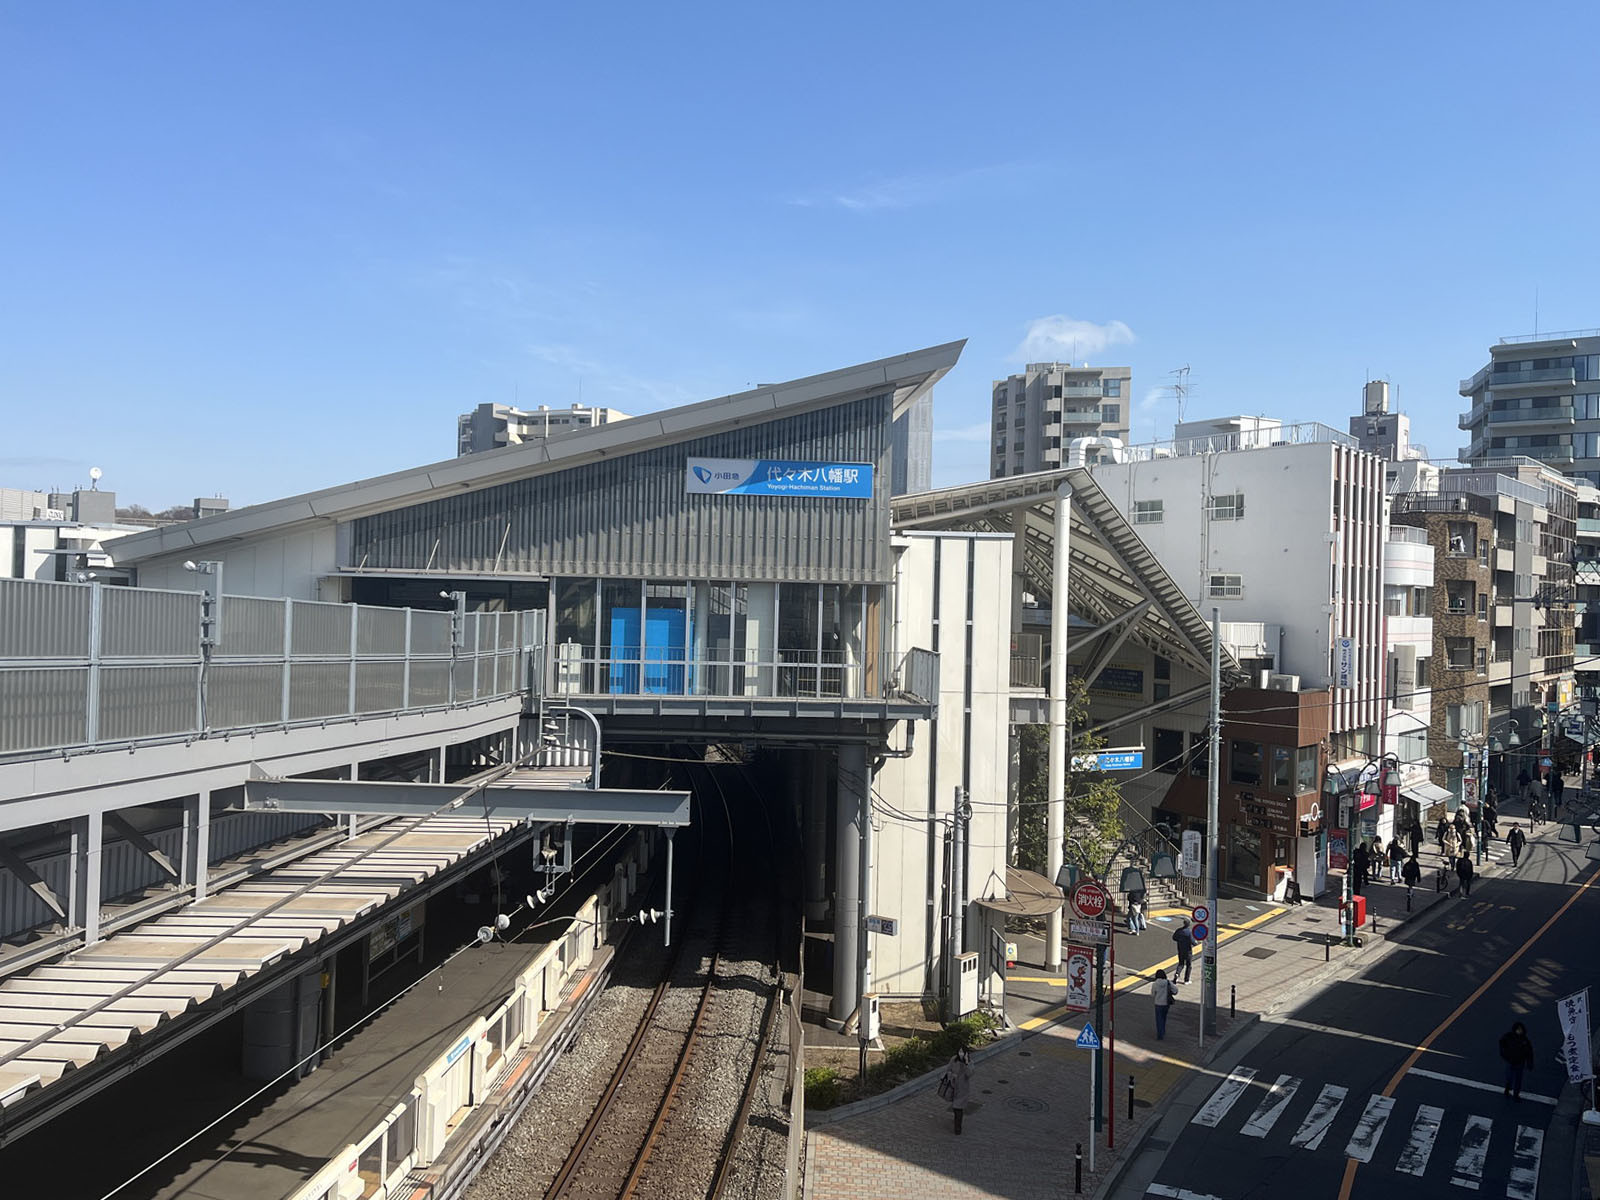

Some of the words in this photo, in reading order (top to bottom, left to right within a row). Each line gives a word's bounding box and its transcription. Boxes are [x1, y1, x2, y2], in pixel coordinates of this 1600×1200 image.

[714, 472, 740, 480] 小田急
[767, 466, 859, 484] 代々木八幡駅
[767, 483, 818, 491] Yoyogi-Hachiman
[1078, 893, 1103, 908] 消火栓
[1196, 910, 1206, 919] 30
